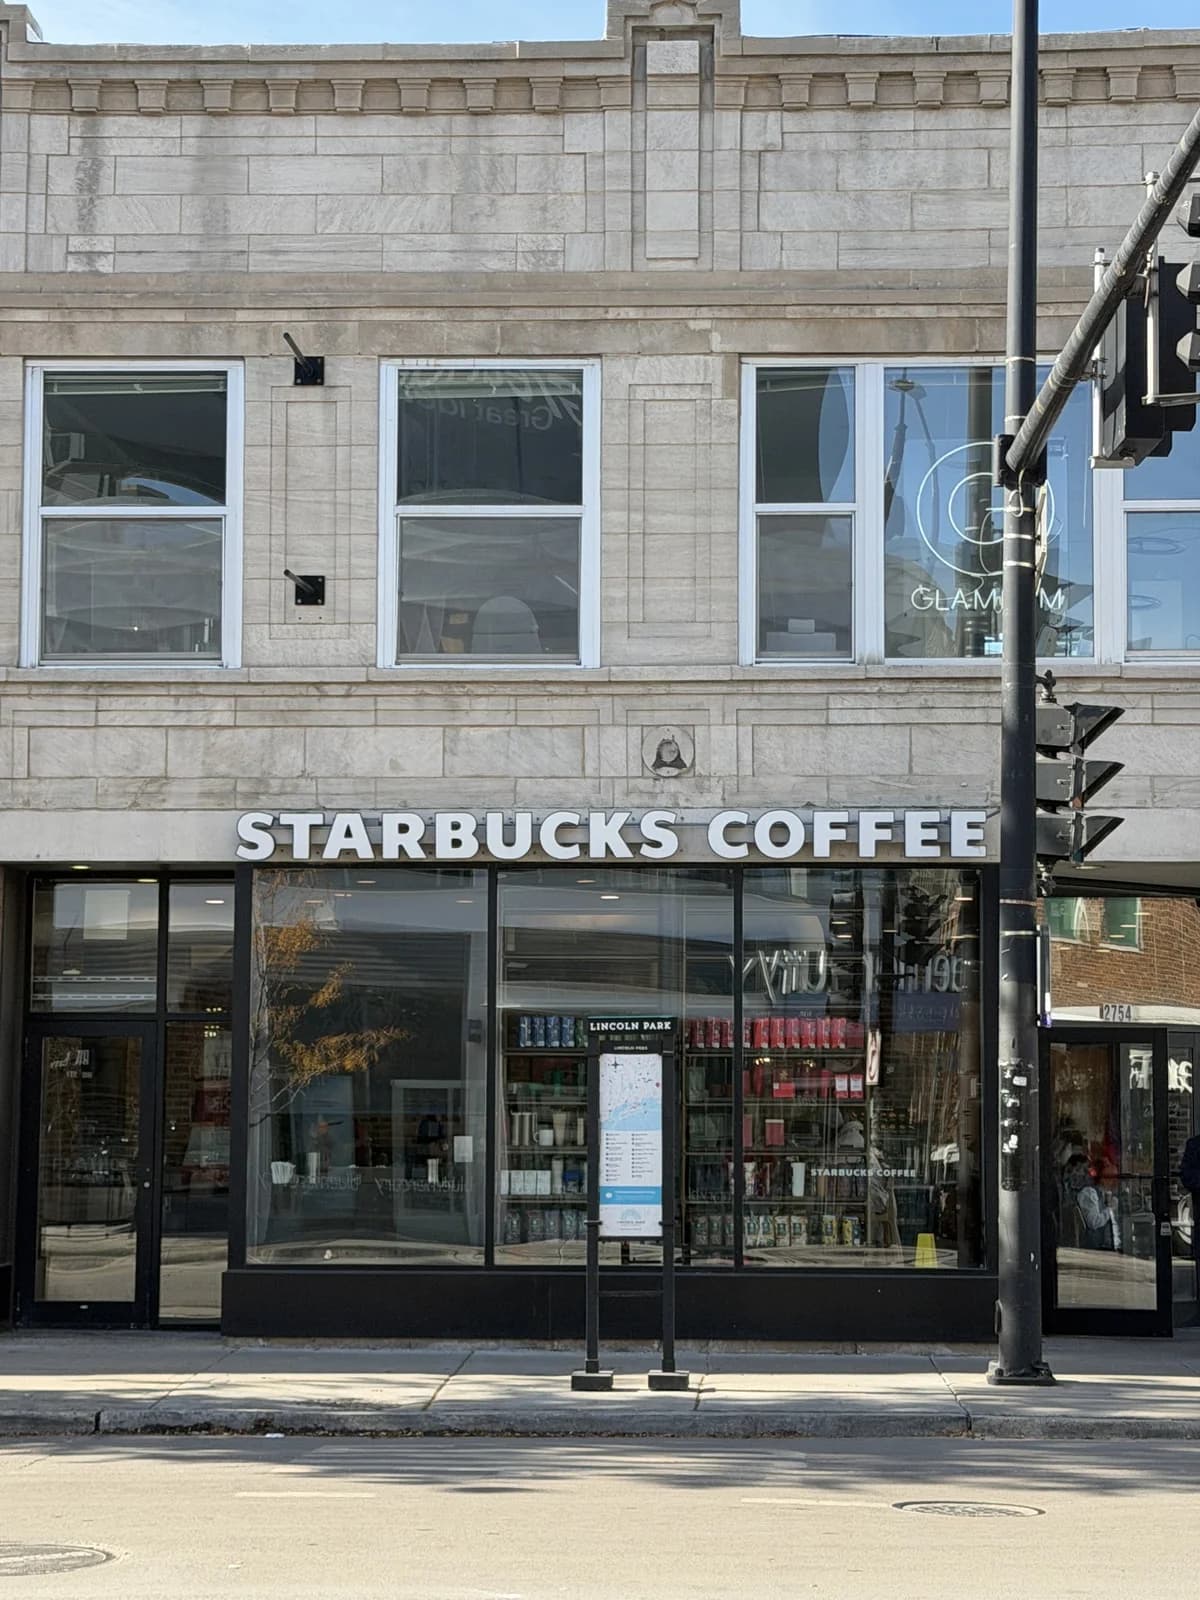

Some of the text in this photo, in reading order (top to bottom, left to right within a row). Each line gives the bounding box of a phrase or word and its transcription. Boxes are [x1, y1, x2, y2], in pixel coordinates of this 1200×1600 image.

[235, 809, 988, 861] STARBUCKS COFFEE
[1104, 1004, 1132, 1022] 2754
[589, 1021, 672, 1031] LINCOLN PARK
[810, 1168, 916, 1177] STARBUCKS COFFEE
